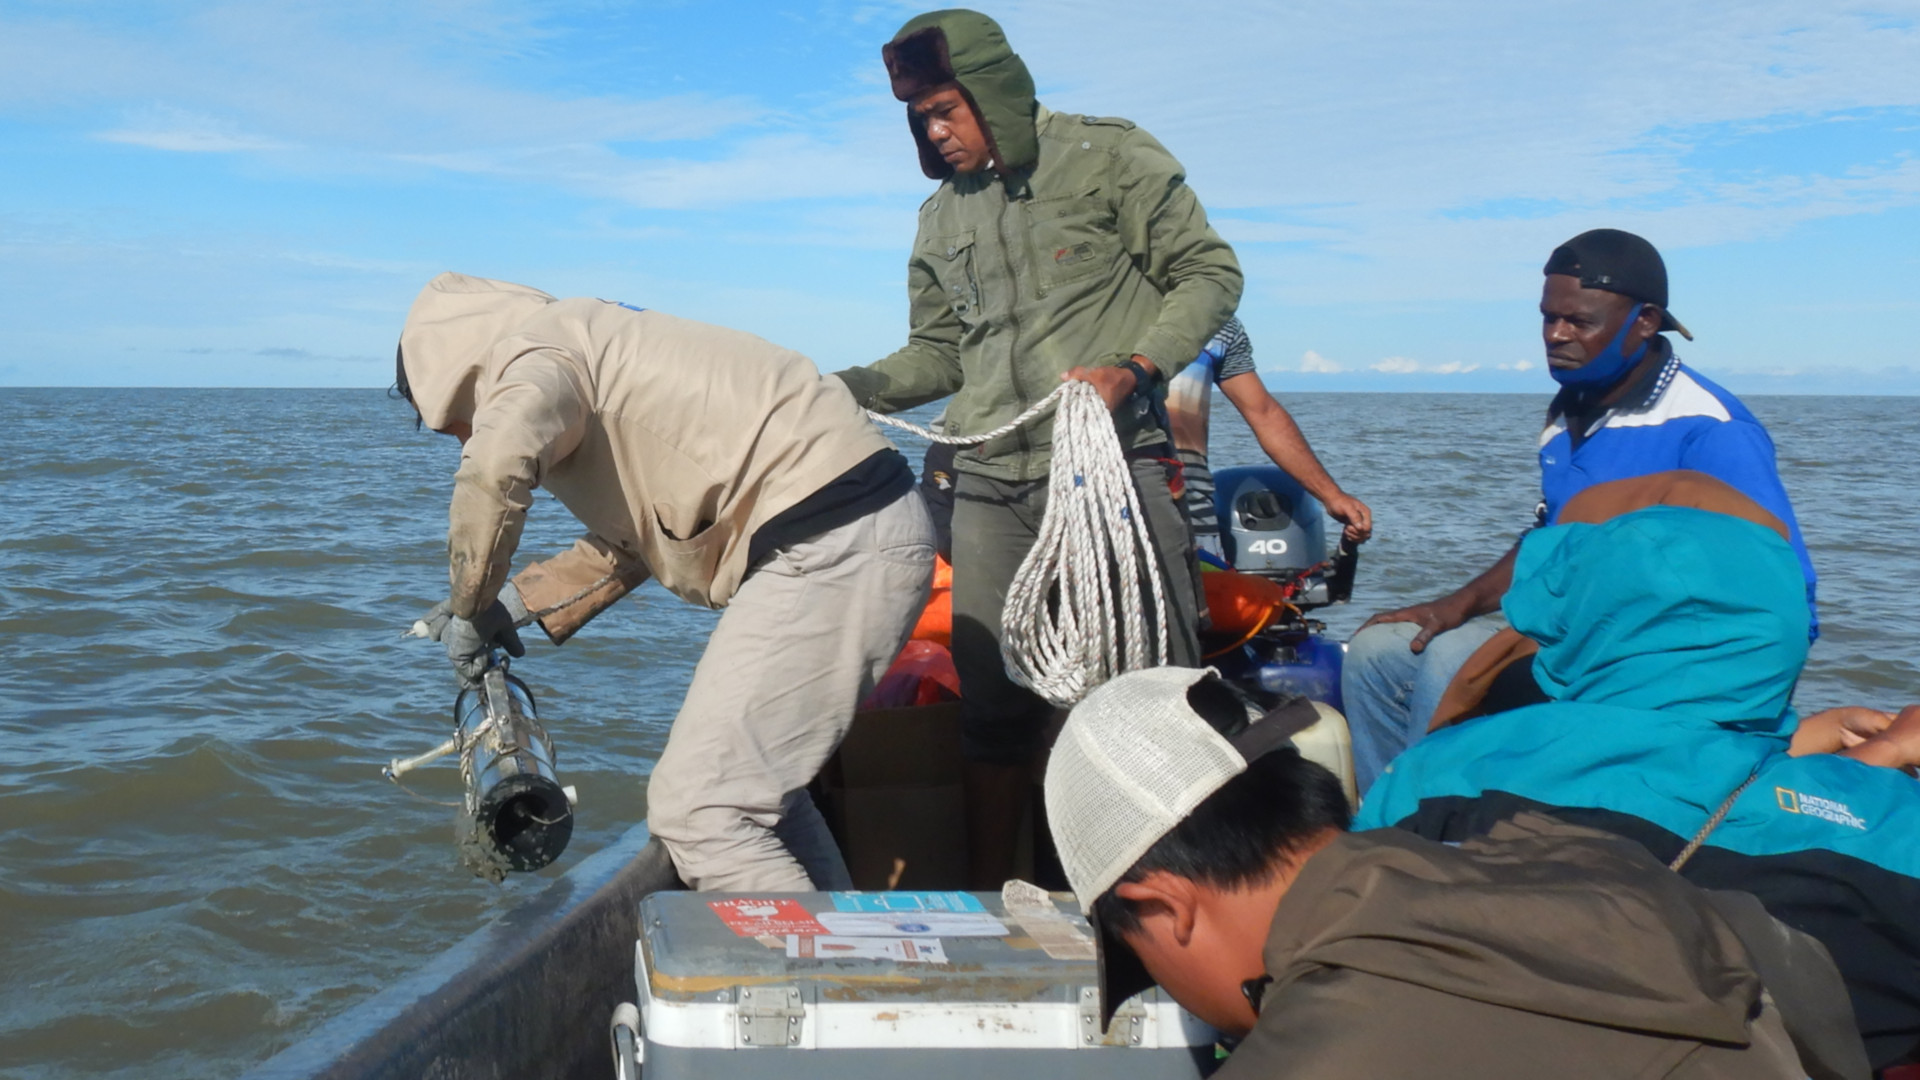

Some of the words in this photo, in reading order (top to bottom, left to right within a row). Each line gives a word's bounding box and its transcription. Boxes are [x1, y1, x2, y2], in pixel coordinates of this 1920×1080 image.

[1248, 538, 1288, 555] 40
[1799, 793, 1850, 815] NATIONAL
[1800, 804, 1866, 830] GEOGRAPHIC
[713, 898, 793, 908] FRAGILE
